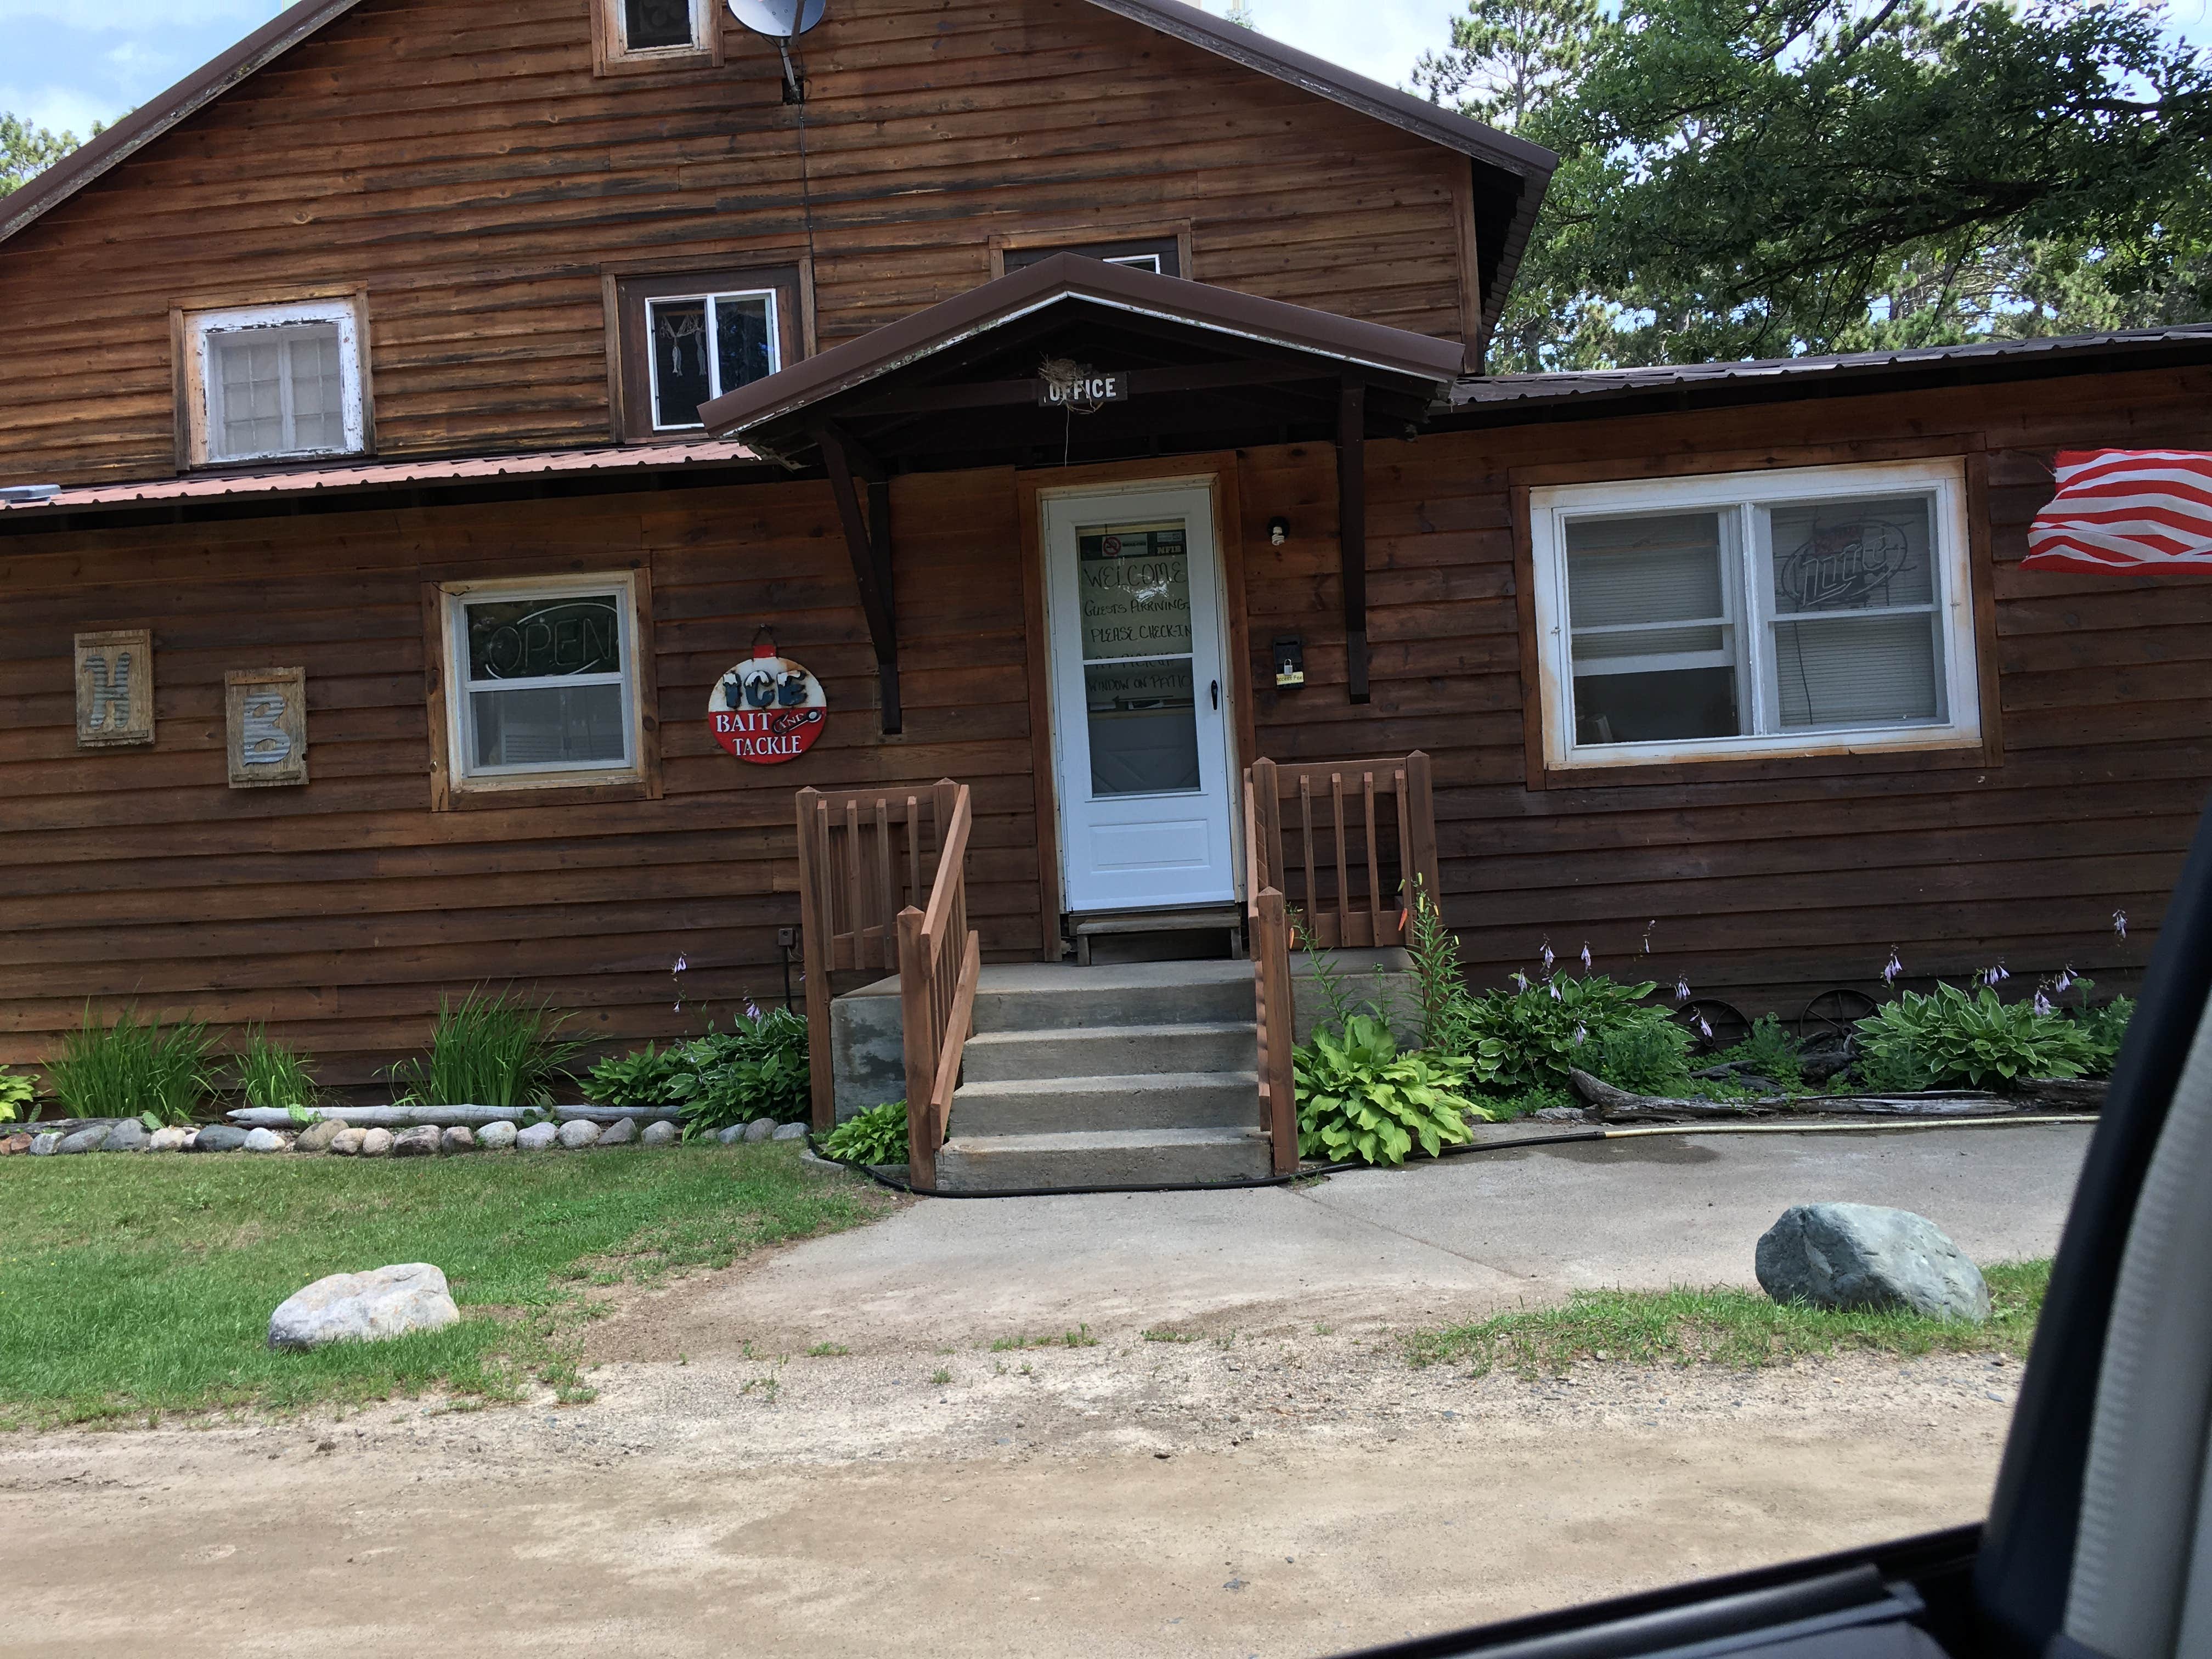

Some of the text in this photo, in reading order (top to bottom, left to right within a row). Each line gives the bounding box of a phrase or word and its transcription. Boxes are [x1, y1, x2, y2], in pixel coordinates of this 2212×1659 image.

[1084, 562, 1186, 588] WELCOME
[1084, 600, 1127, 617] GUESTS
[489, 616, 612, 672] OPEN
[1091, 627, 1138, 642] PLEASE
[723, 670, 809, 708] ICE
[1087, 675, 1192, 692] WINDOW ON PATIO
[243, 691, 291, 767] B
[715, 713, 772, 732] BAIT
[732, 736, 802, 756] TACKLE
